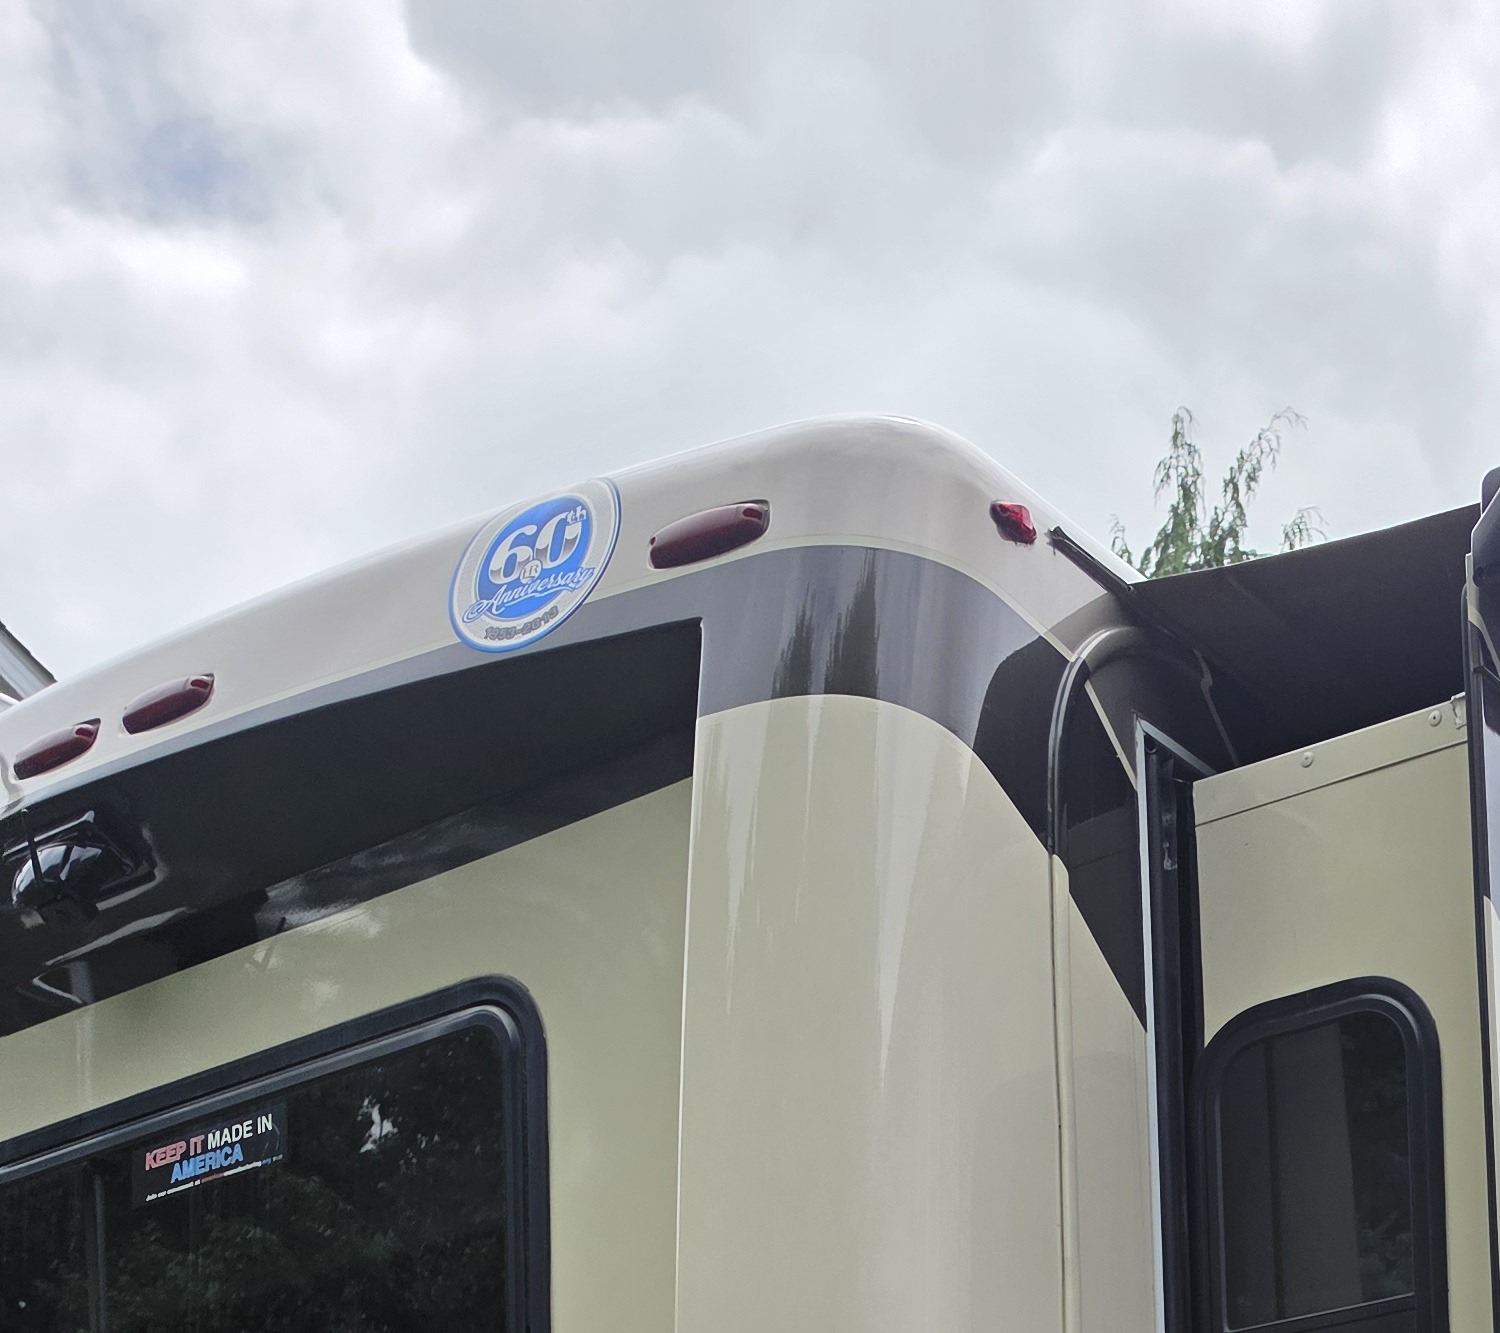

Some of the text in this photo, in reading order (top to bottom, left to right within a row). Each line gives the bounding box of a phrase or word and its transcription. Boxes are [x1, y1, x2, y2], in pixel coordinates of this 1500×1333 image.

[462, 567, 595, 623] Anniversary
[484, 606, 559, 640] 1953-2013
[145, 1113, 273, 1171] KEEP IT MADE IN
[170, 1143, 244, 1184] AMERICA
